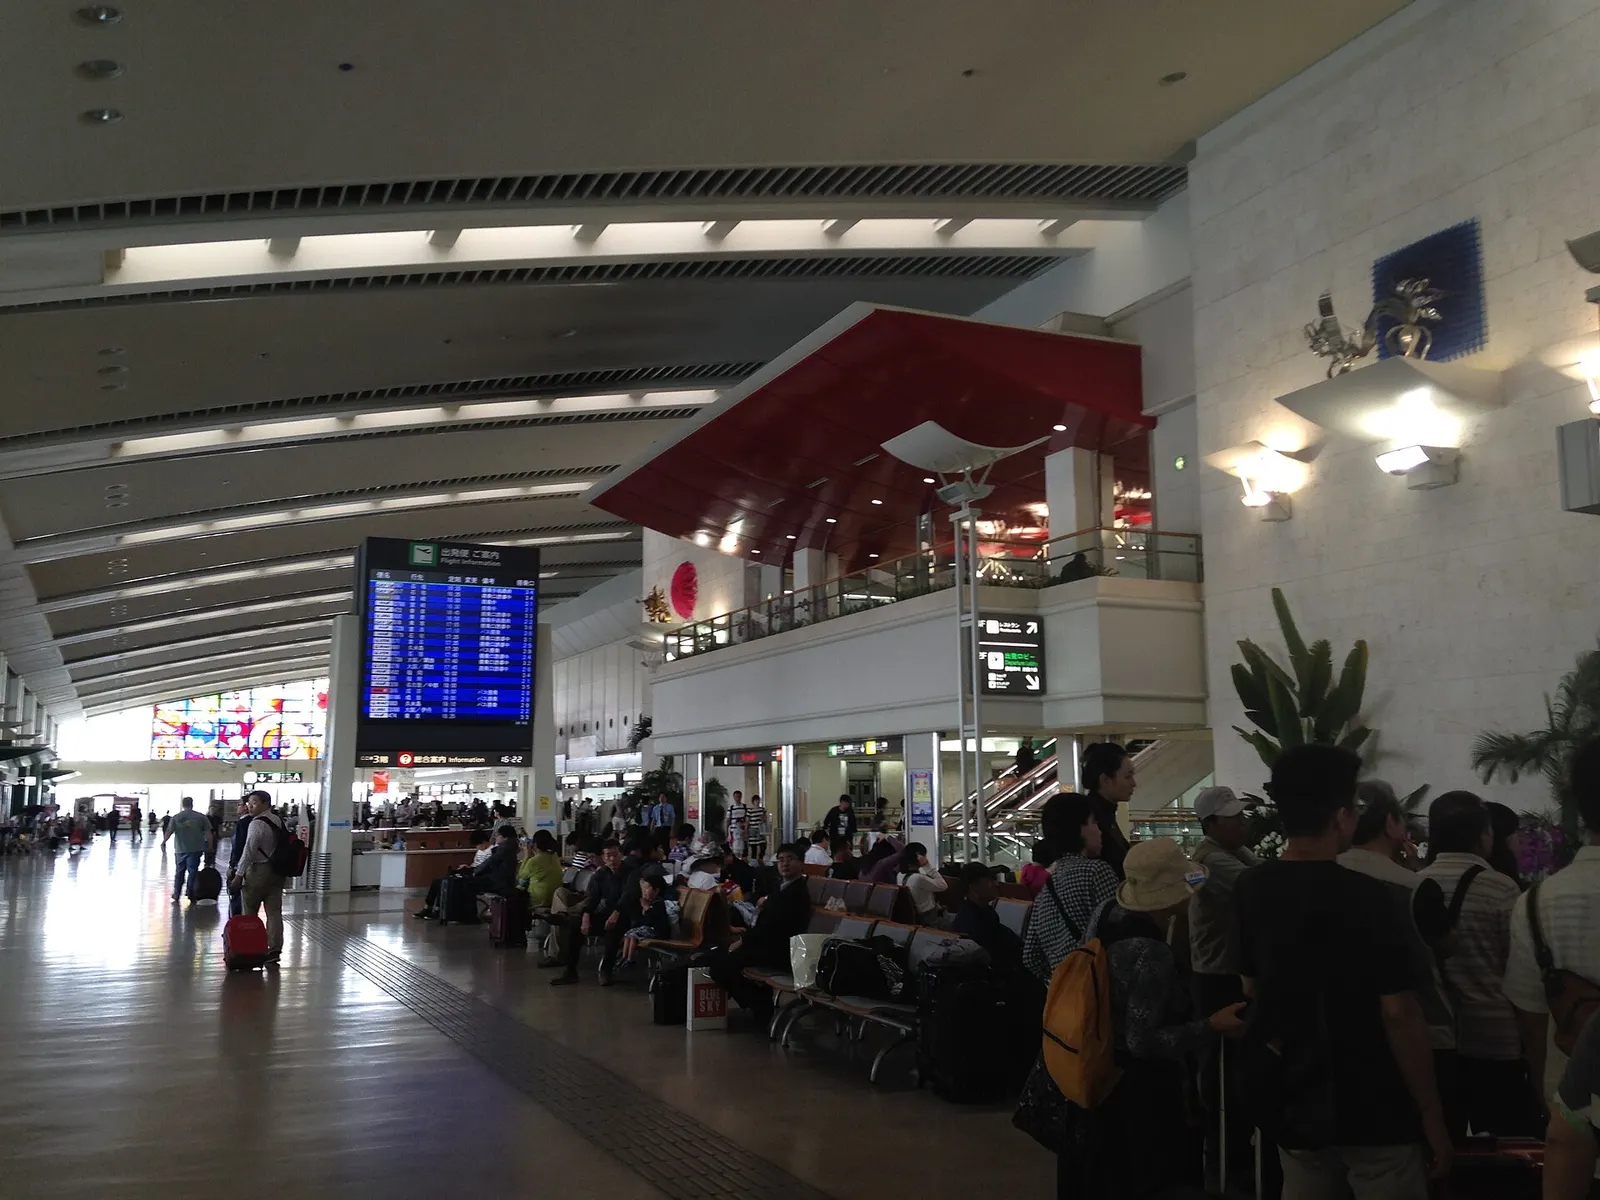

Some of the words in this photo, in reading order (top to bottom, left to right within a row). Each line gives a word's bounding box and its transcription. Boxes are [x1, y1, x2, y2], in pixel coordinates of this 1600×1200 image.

[414, 755, 447, 764] 総合案内
[293, 773, 301, 781] A
[700, 988, 720, 1000] BLUE
[700, 1001, 720, 1012] SKY
